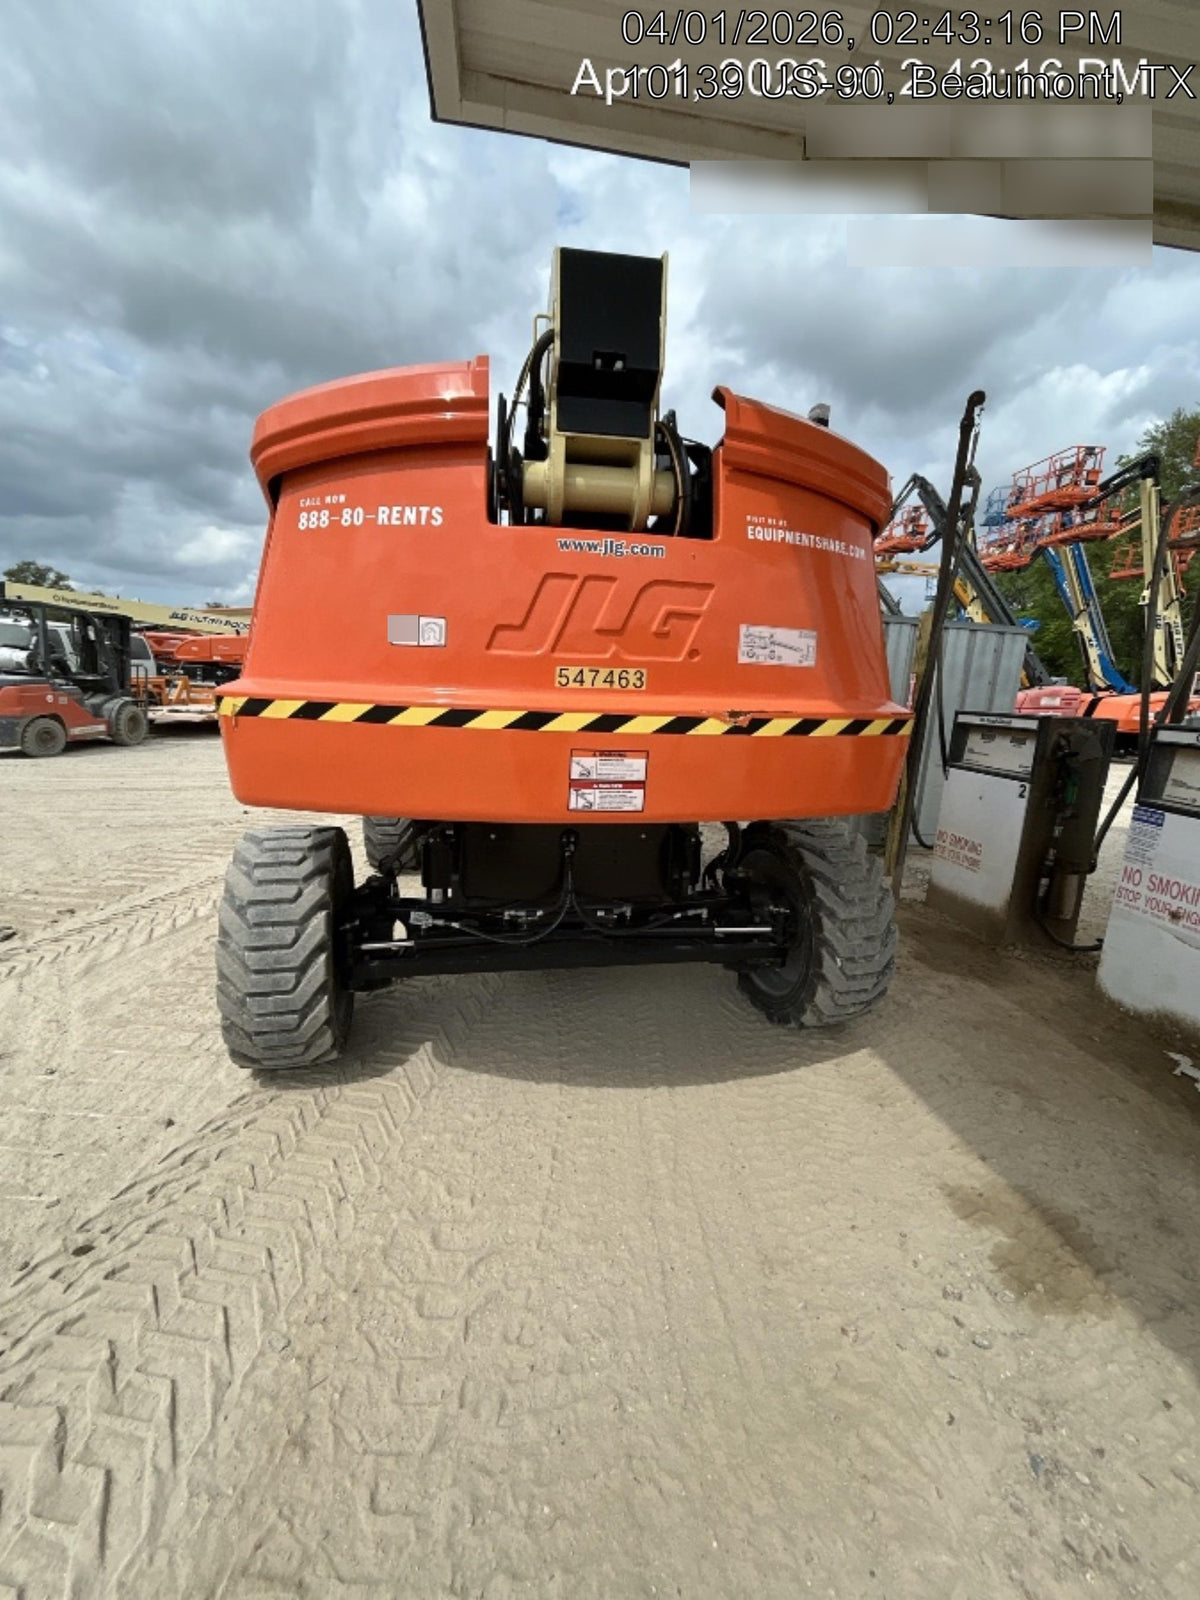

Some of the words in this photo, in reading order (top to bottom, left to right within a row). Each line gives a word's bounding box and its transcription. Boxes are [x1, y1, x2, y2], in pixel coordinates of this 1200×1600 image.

[298, 506, 444, 531] 888-80-RENTS
[557, 538, 666, 558] www.jlg.com
[557, 668, 645, 689] 547463
[1018, 783, 1027, 799] 2
[1121, 865, 1143, 887] NO
